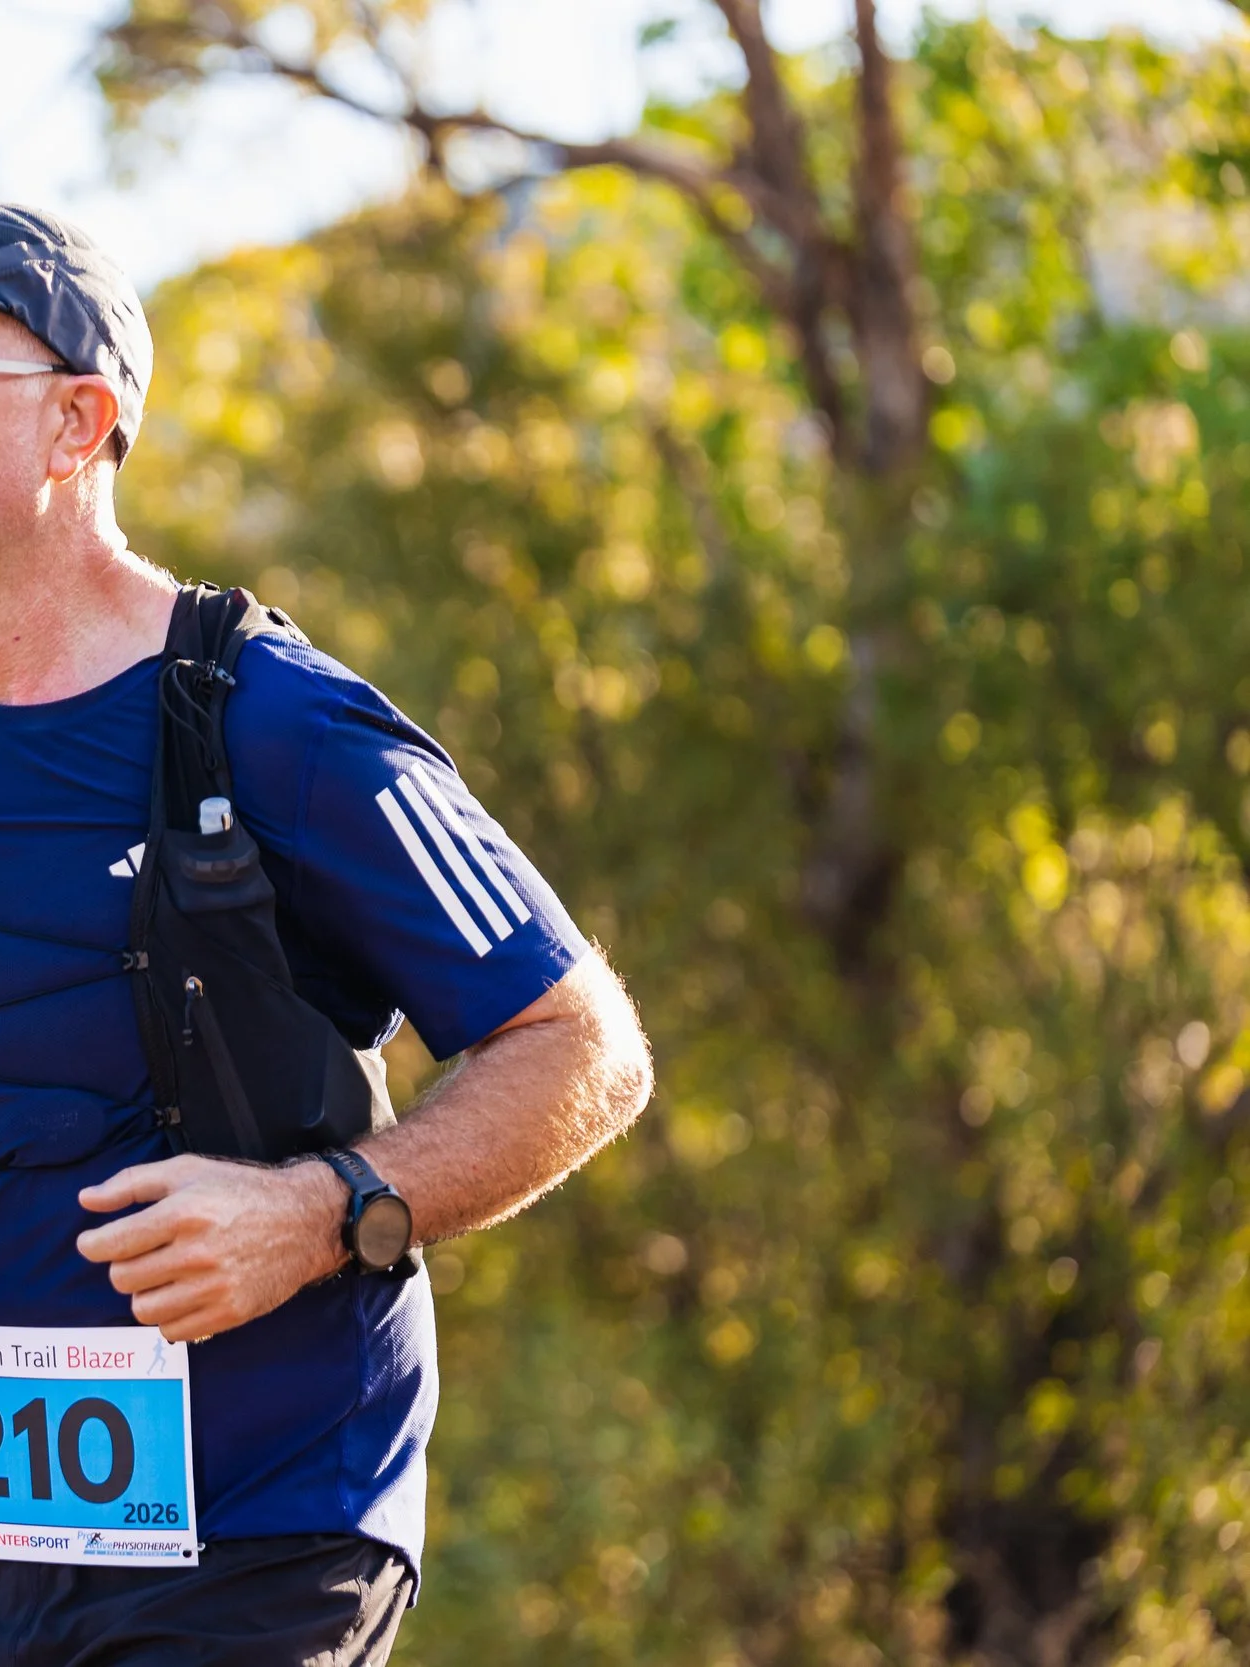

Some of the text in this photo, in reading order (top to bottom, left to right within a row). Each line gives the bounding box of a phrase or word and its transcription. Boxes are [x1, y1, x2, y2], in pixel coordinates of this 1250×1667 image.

[11, 1344, 57, 1368] Trail
[67, 1346, 135, 1369] Blazer
[123, 1503, 180, 1525] 2026
